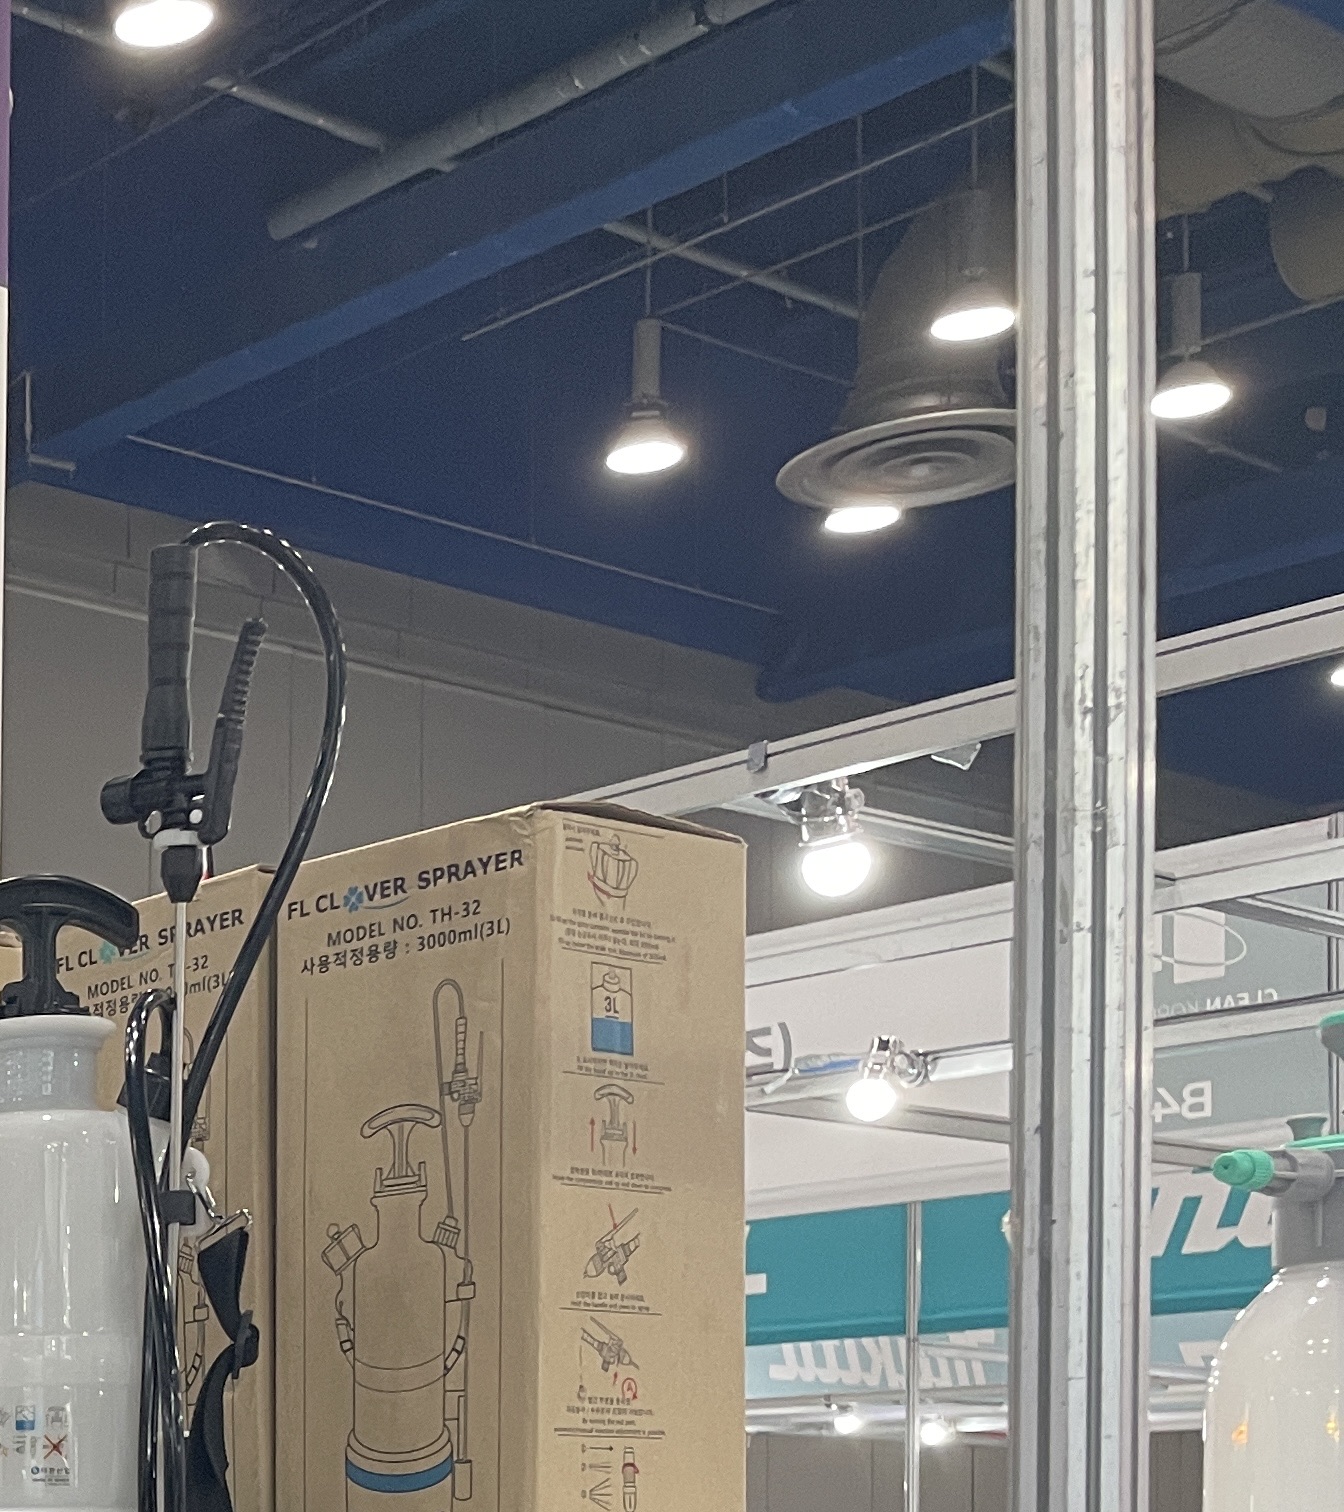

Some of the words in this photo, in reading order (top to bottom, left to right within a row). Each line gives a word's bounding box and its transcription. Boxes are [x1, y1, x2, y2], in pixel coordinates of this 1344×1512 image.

[287, 902, 310, 921] FL
[417, 849, 525, 890] SPRAYER
[301, 939, 399, 976] 사용적정용량
[416, 918, 512, 952] 3000ml(3L)
[327, 922, 386, 948] MODEL
[392, 914, 424, 935] NO.
[429, 899, 482, 926] TH-32
[87, 974, 133, 1000] MODEL
[168, 954, 209, 979] T-32
[603, 995, 621, 1018] 3L
